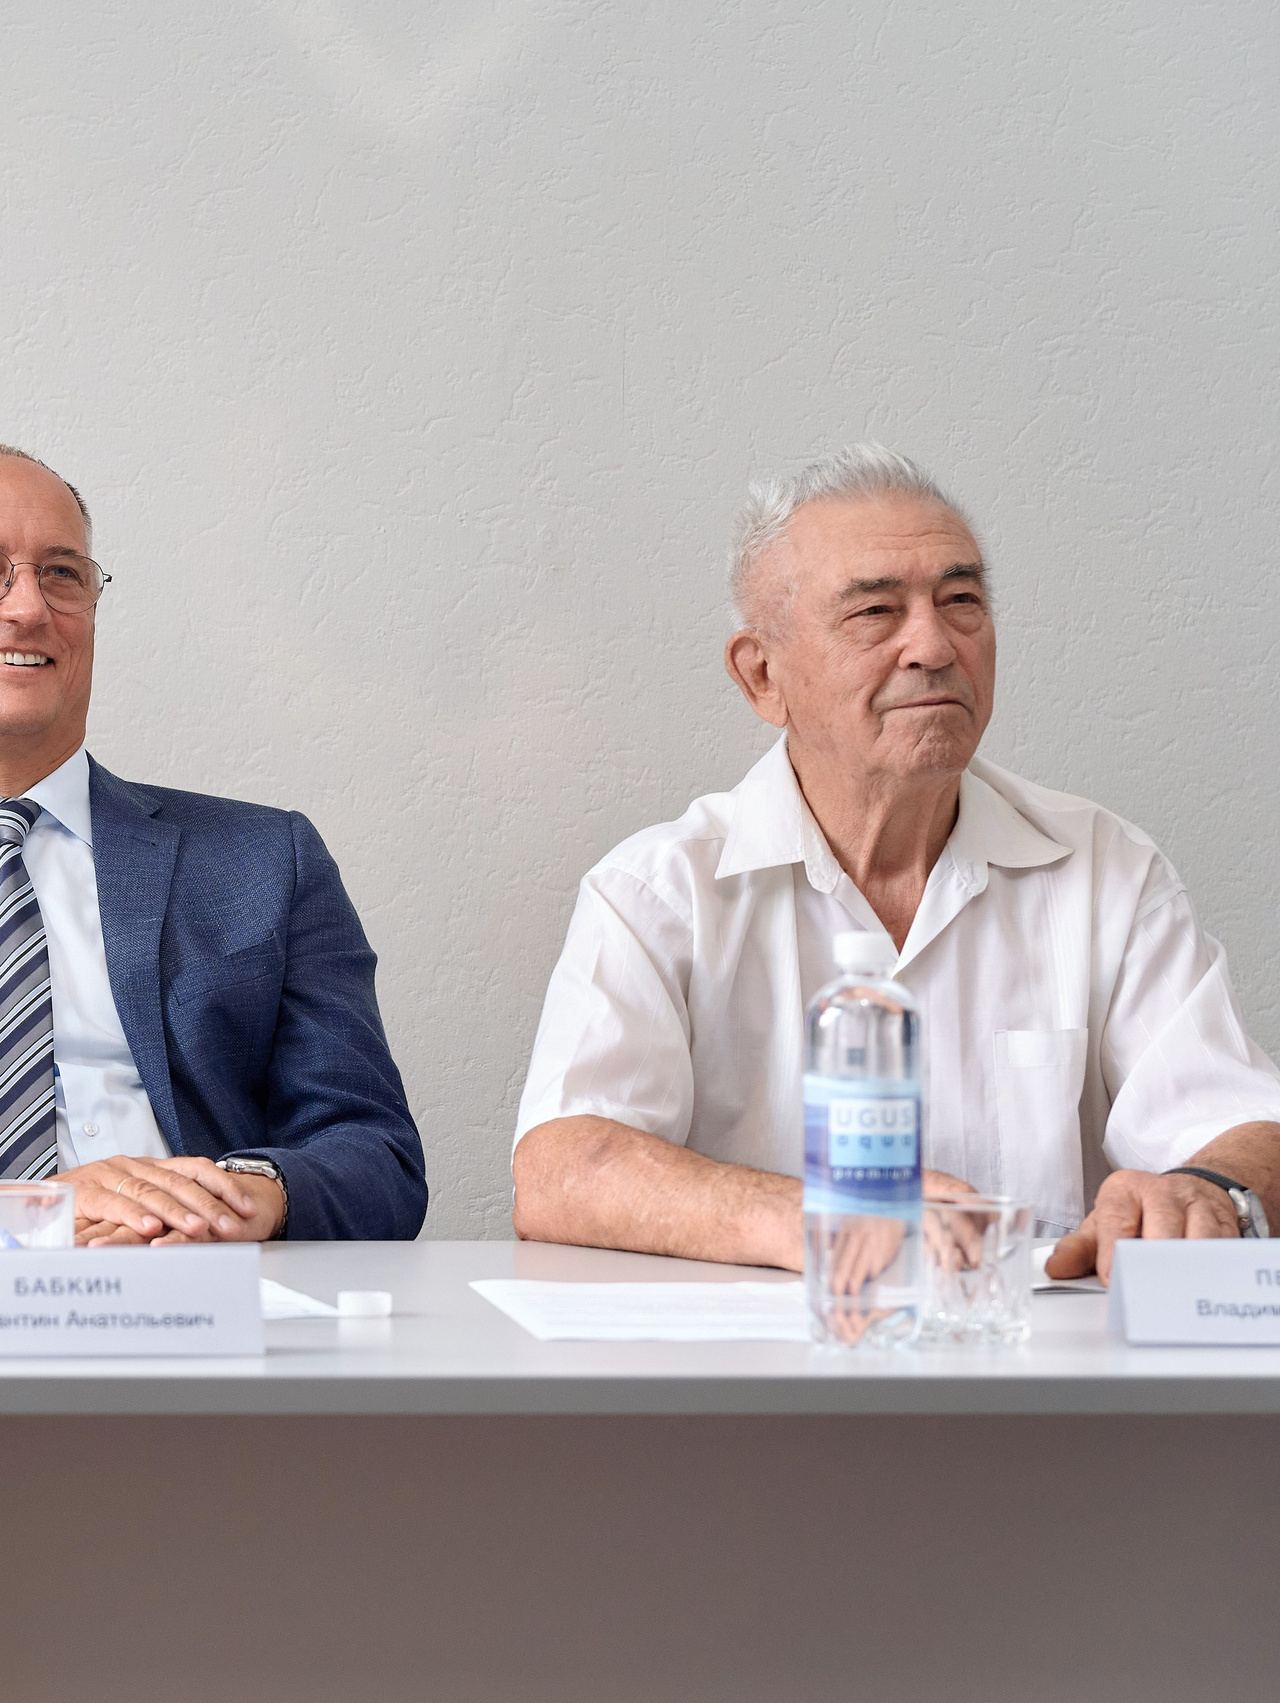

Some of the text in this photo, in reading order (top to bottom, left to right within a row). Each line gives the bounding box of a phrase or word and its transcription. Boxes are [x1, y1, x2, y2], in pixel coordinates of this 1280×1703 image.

[836, 1107, 914, 1128] UGUS
[14, 1276, 122, 1297] БАБКИН
[65, 1309, 215, 1330] Анатольевич
